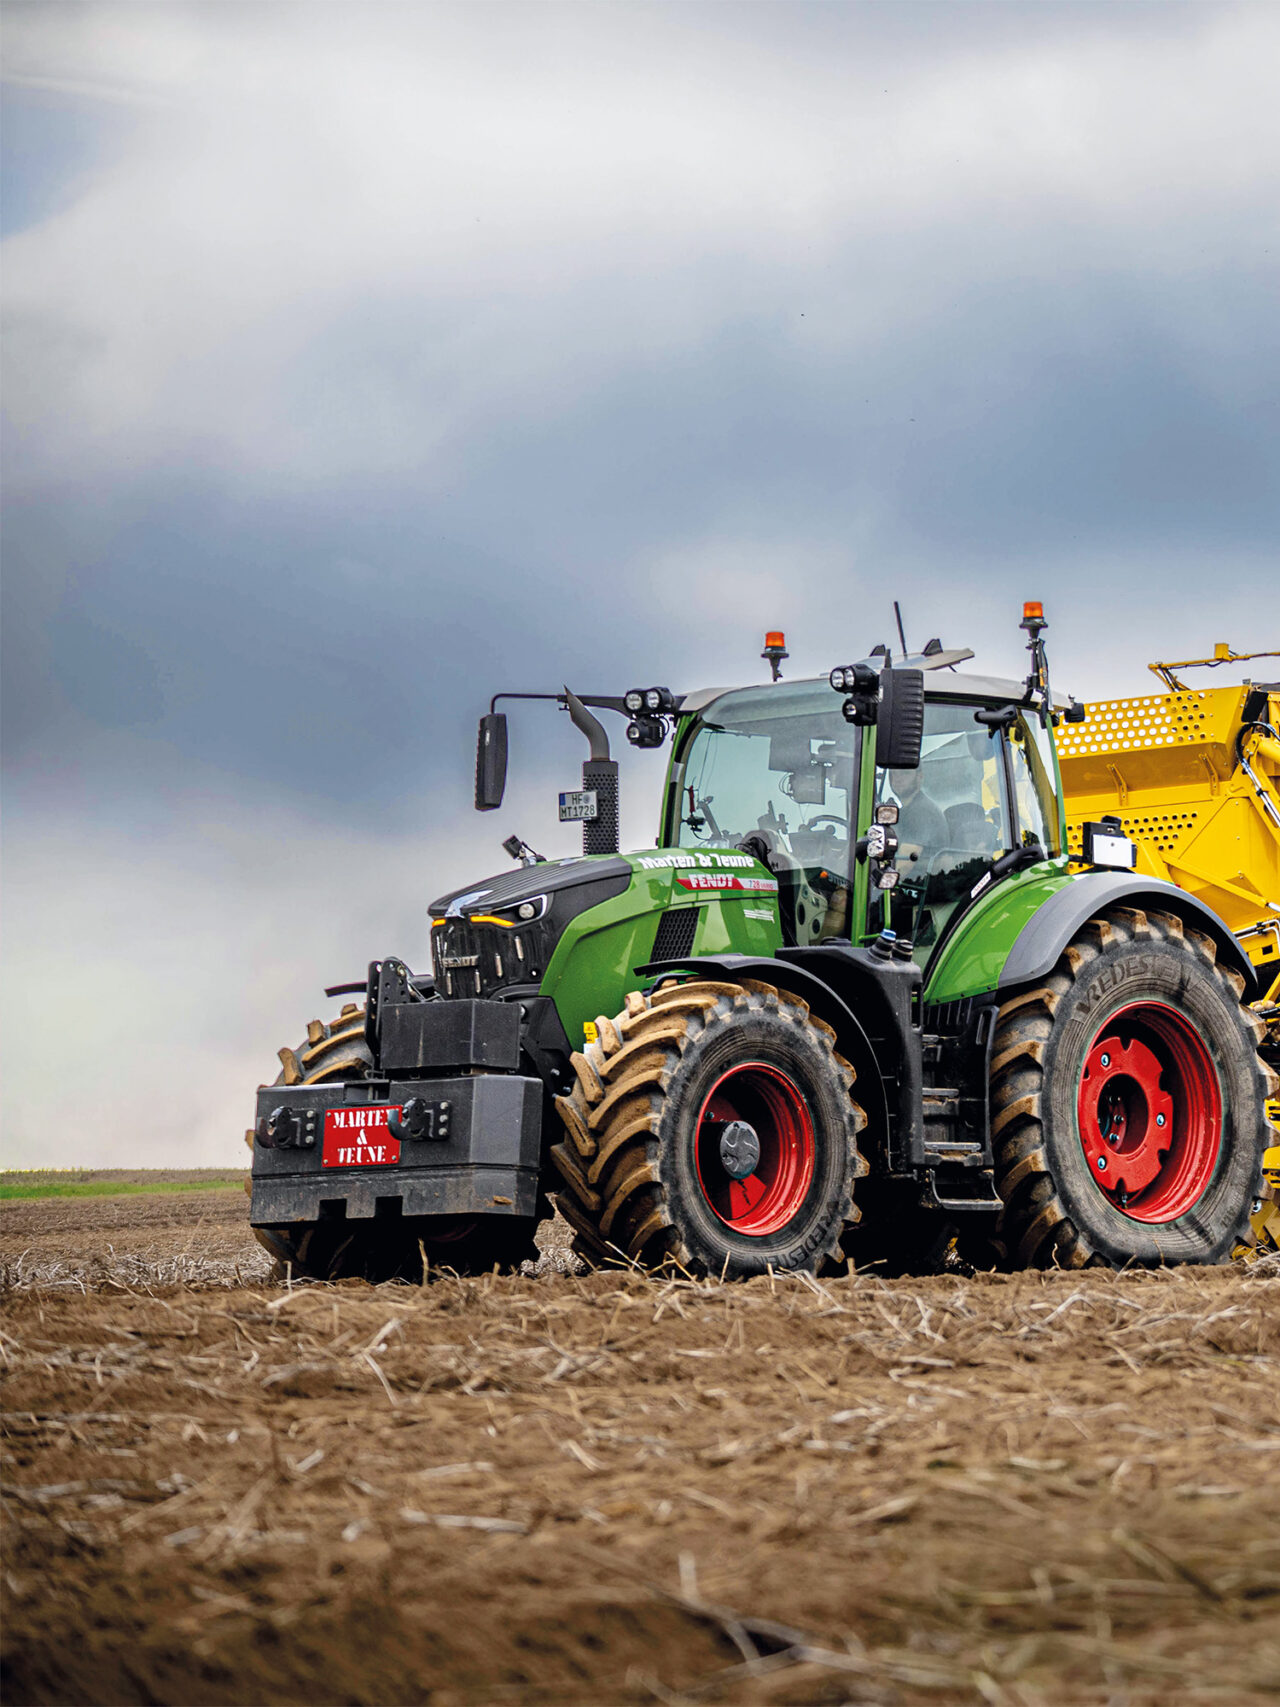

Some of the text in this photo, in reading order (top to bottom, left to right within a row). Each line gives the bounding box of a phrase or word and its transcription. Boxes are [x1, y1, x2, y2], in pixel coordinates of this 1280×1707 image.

[571, 793, 583, 805] HF
[560, 805, 595, 818] MT1728
[637, 853, 755, 870] Marten & Teune
[688, 873, 735, 888] FENDT
[356, 1128, 368, 1145] &
[337, 1145, 387, 1163] TEUNE
